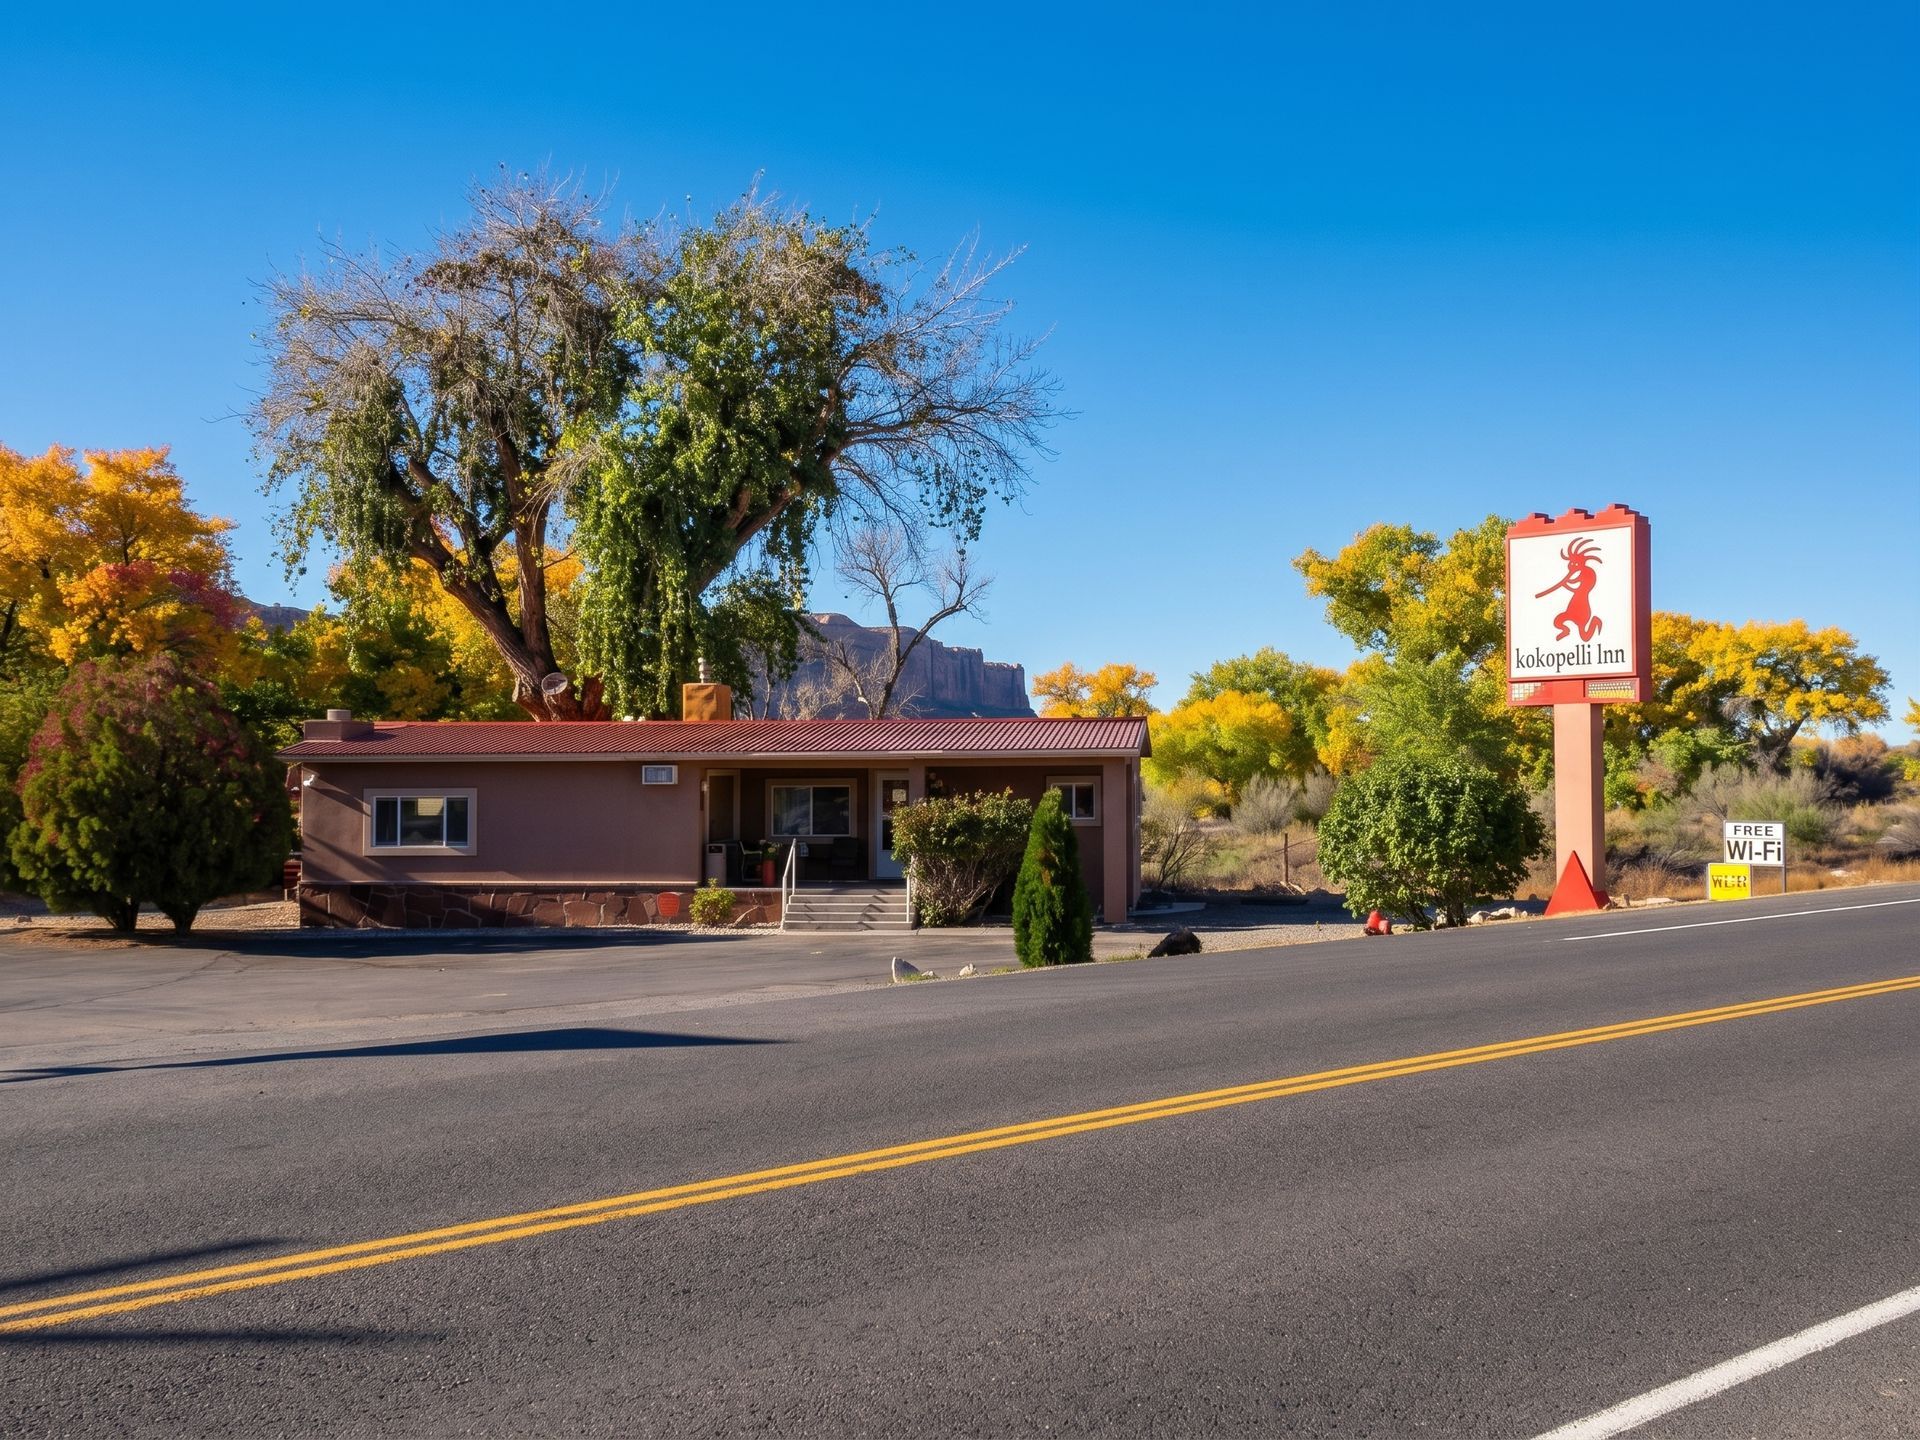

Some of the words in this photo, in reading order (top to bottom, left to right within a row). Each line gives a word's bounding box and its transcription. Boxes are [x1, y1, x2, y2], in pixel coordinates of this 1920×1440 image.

[1515, 644, 1593, 673] kokopelli
[1597, 643, 1626, 665] Inn
[1733, 825, 1774, 836] FREE
